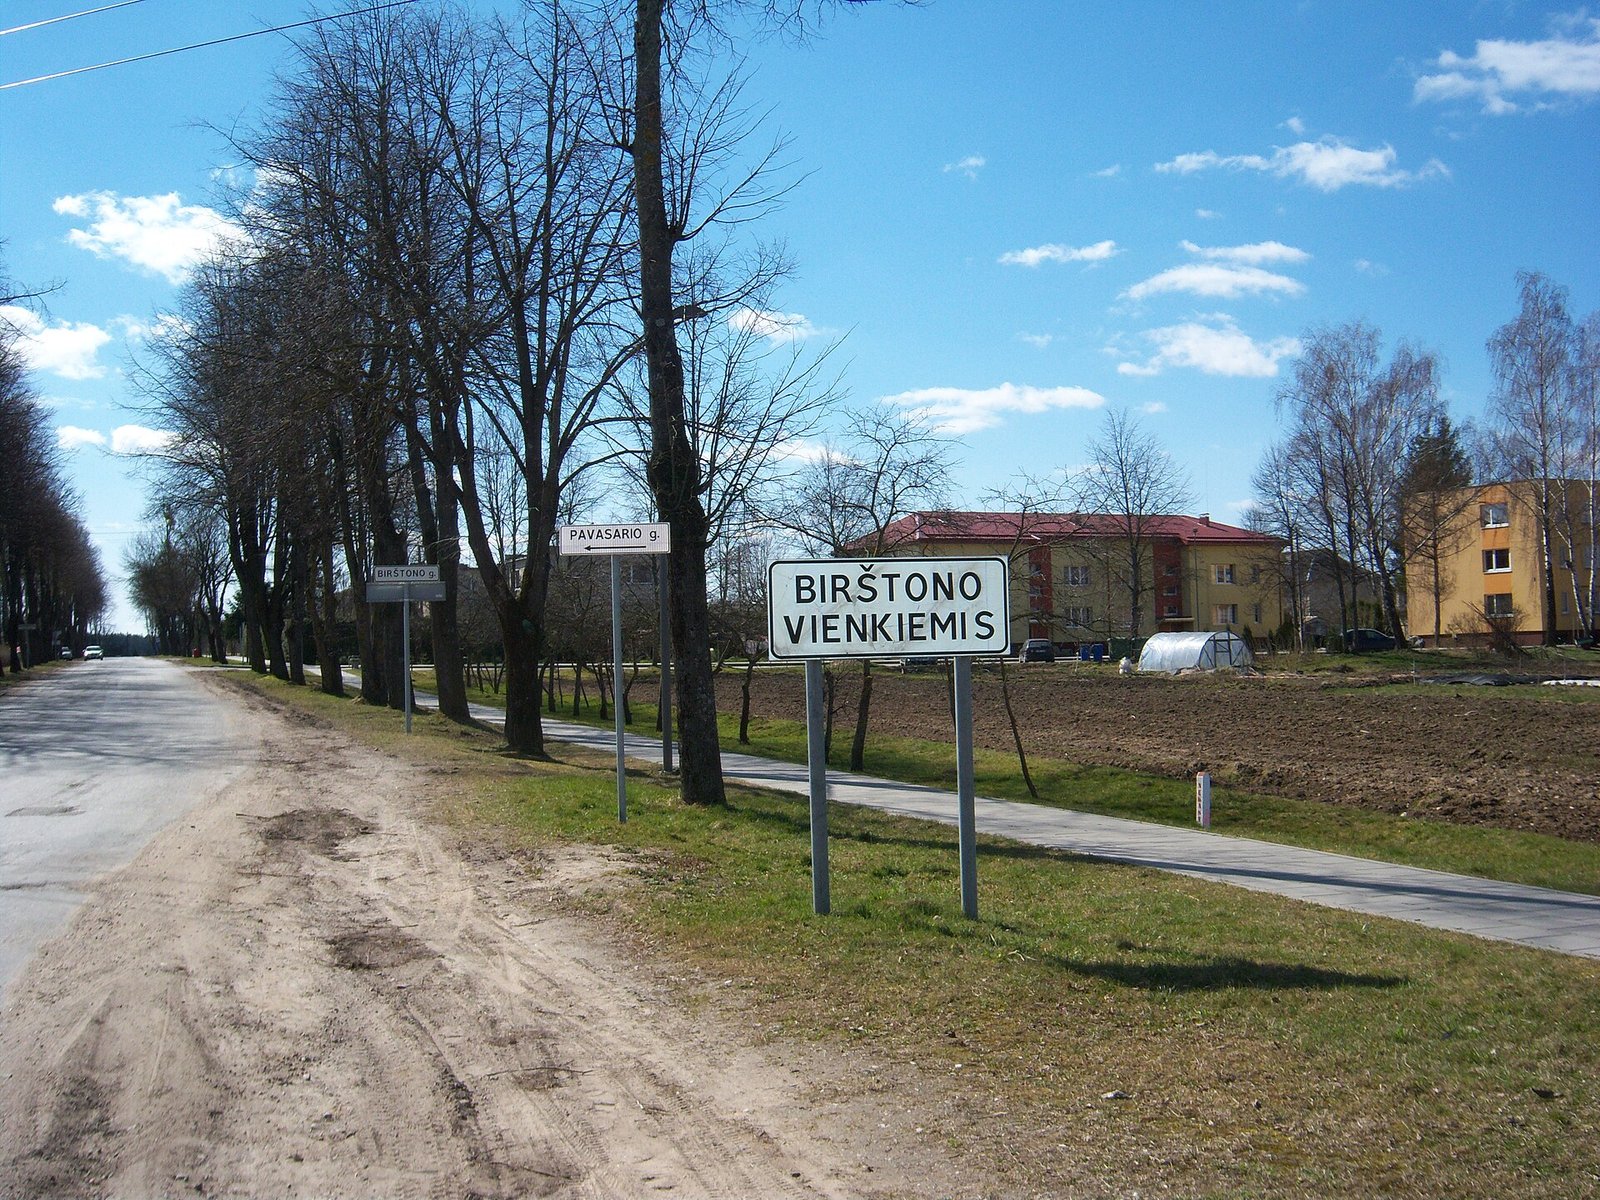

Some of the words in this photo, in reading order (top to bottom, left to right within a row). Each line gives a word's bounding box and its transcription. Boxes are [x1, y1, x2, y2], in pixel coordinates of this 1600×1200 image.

[570, 528, 642, 540] PAVASARIO
[649, 530, 660, 541] g.
[377, 568, 426, 578] BIRŠTONO
[428, 570, 436, 579] g.
[795, 564, 982, 604] BIRŠTONO
[783, 611, 995, 644] VIENKIEMIS
